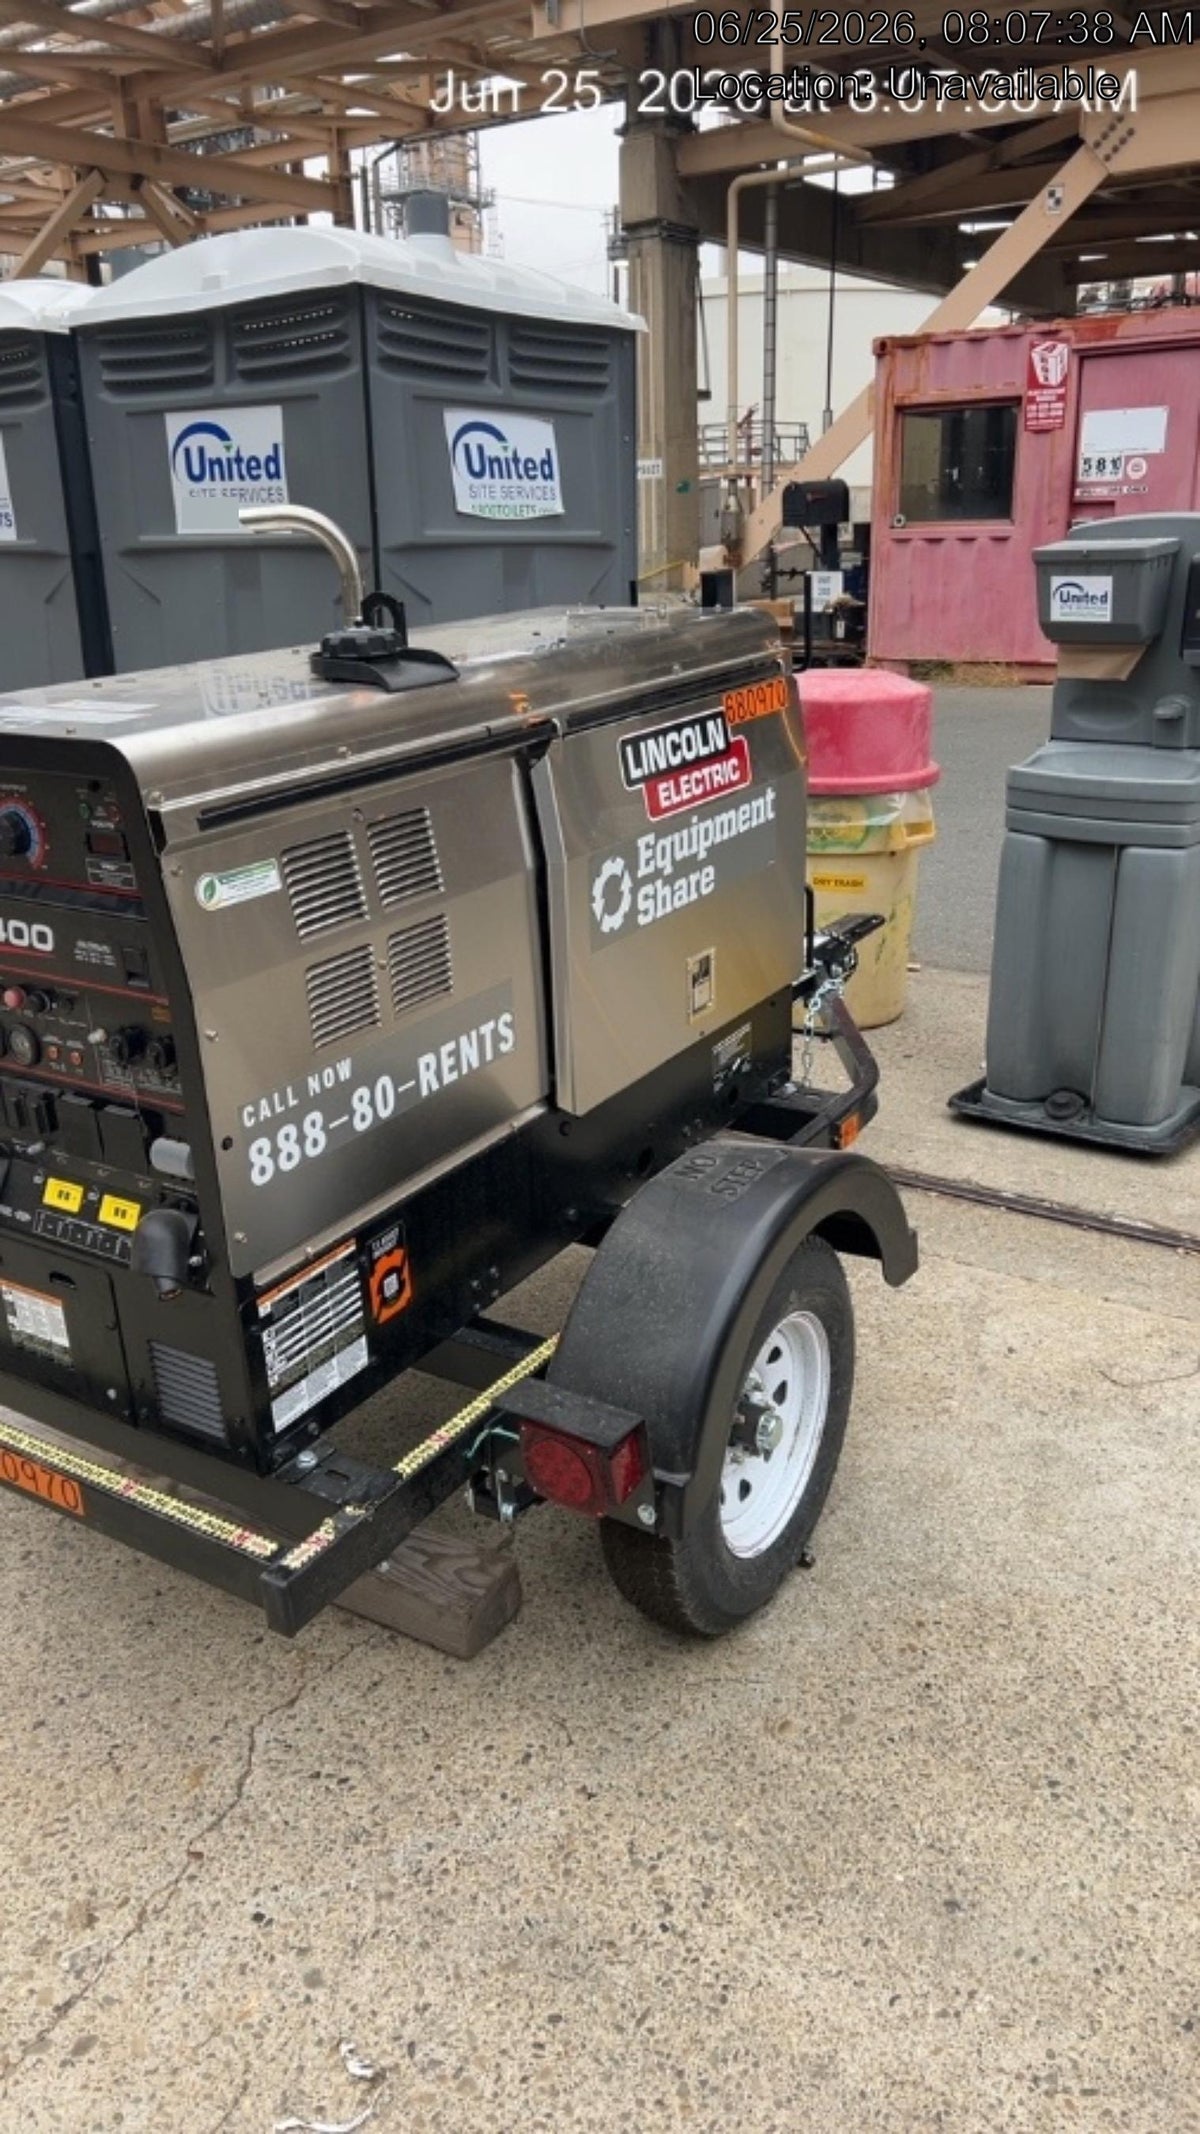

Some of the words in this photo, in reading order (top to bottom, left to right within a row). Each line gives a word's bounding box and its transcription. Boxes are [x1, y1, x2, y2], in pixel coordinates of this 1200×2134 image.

[183, 443, 283, 483] United
[463, 442, 555, 482] United
[468, 484, 497, 499] SITE
[500, 485, 557, 501] SERVICES
[1059, 590, 1109, 605] United
[725, 680, 786, 724] 680970
[625, 716, 727, 780] LINCOLN
[657, 757, 741, 809] ELECTRIC
[637, 787, 776, 878] Equipment
[637, 864, 716, 926] Share
[243, 1085, 299, 1128] CALL
[308, 1057, 352, 1096] NOW
[248, 1012, 516, 1187] 888-80-RENTS
